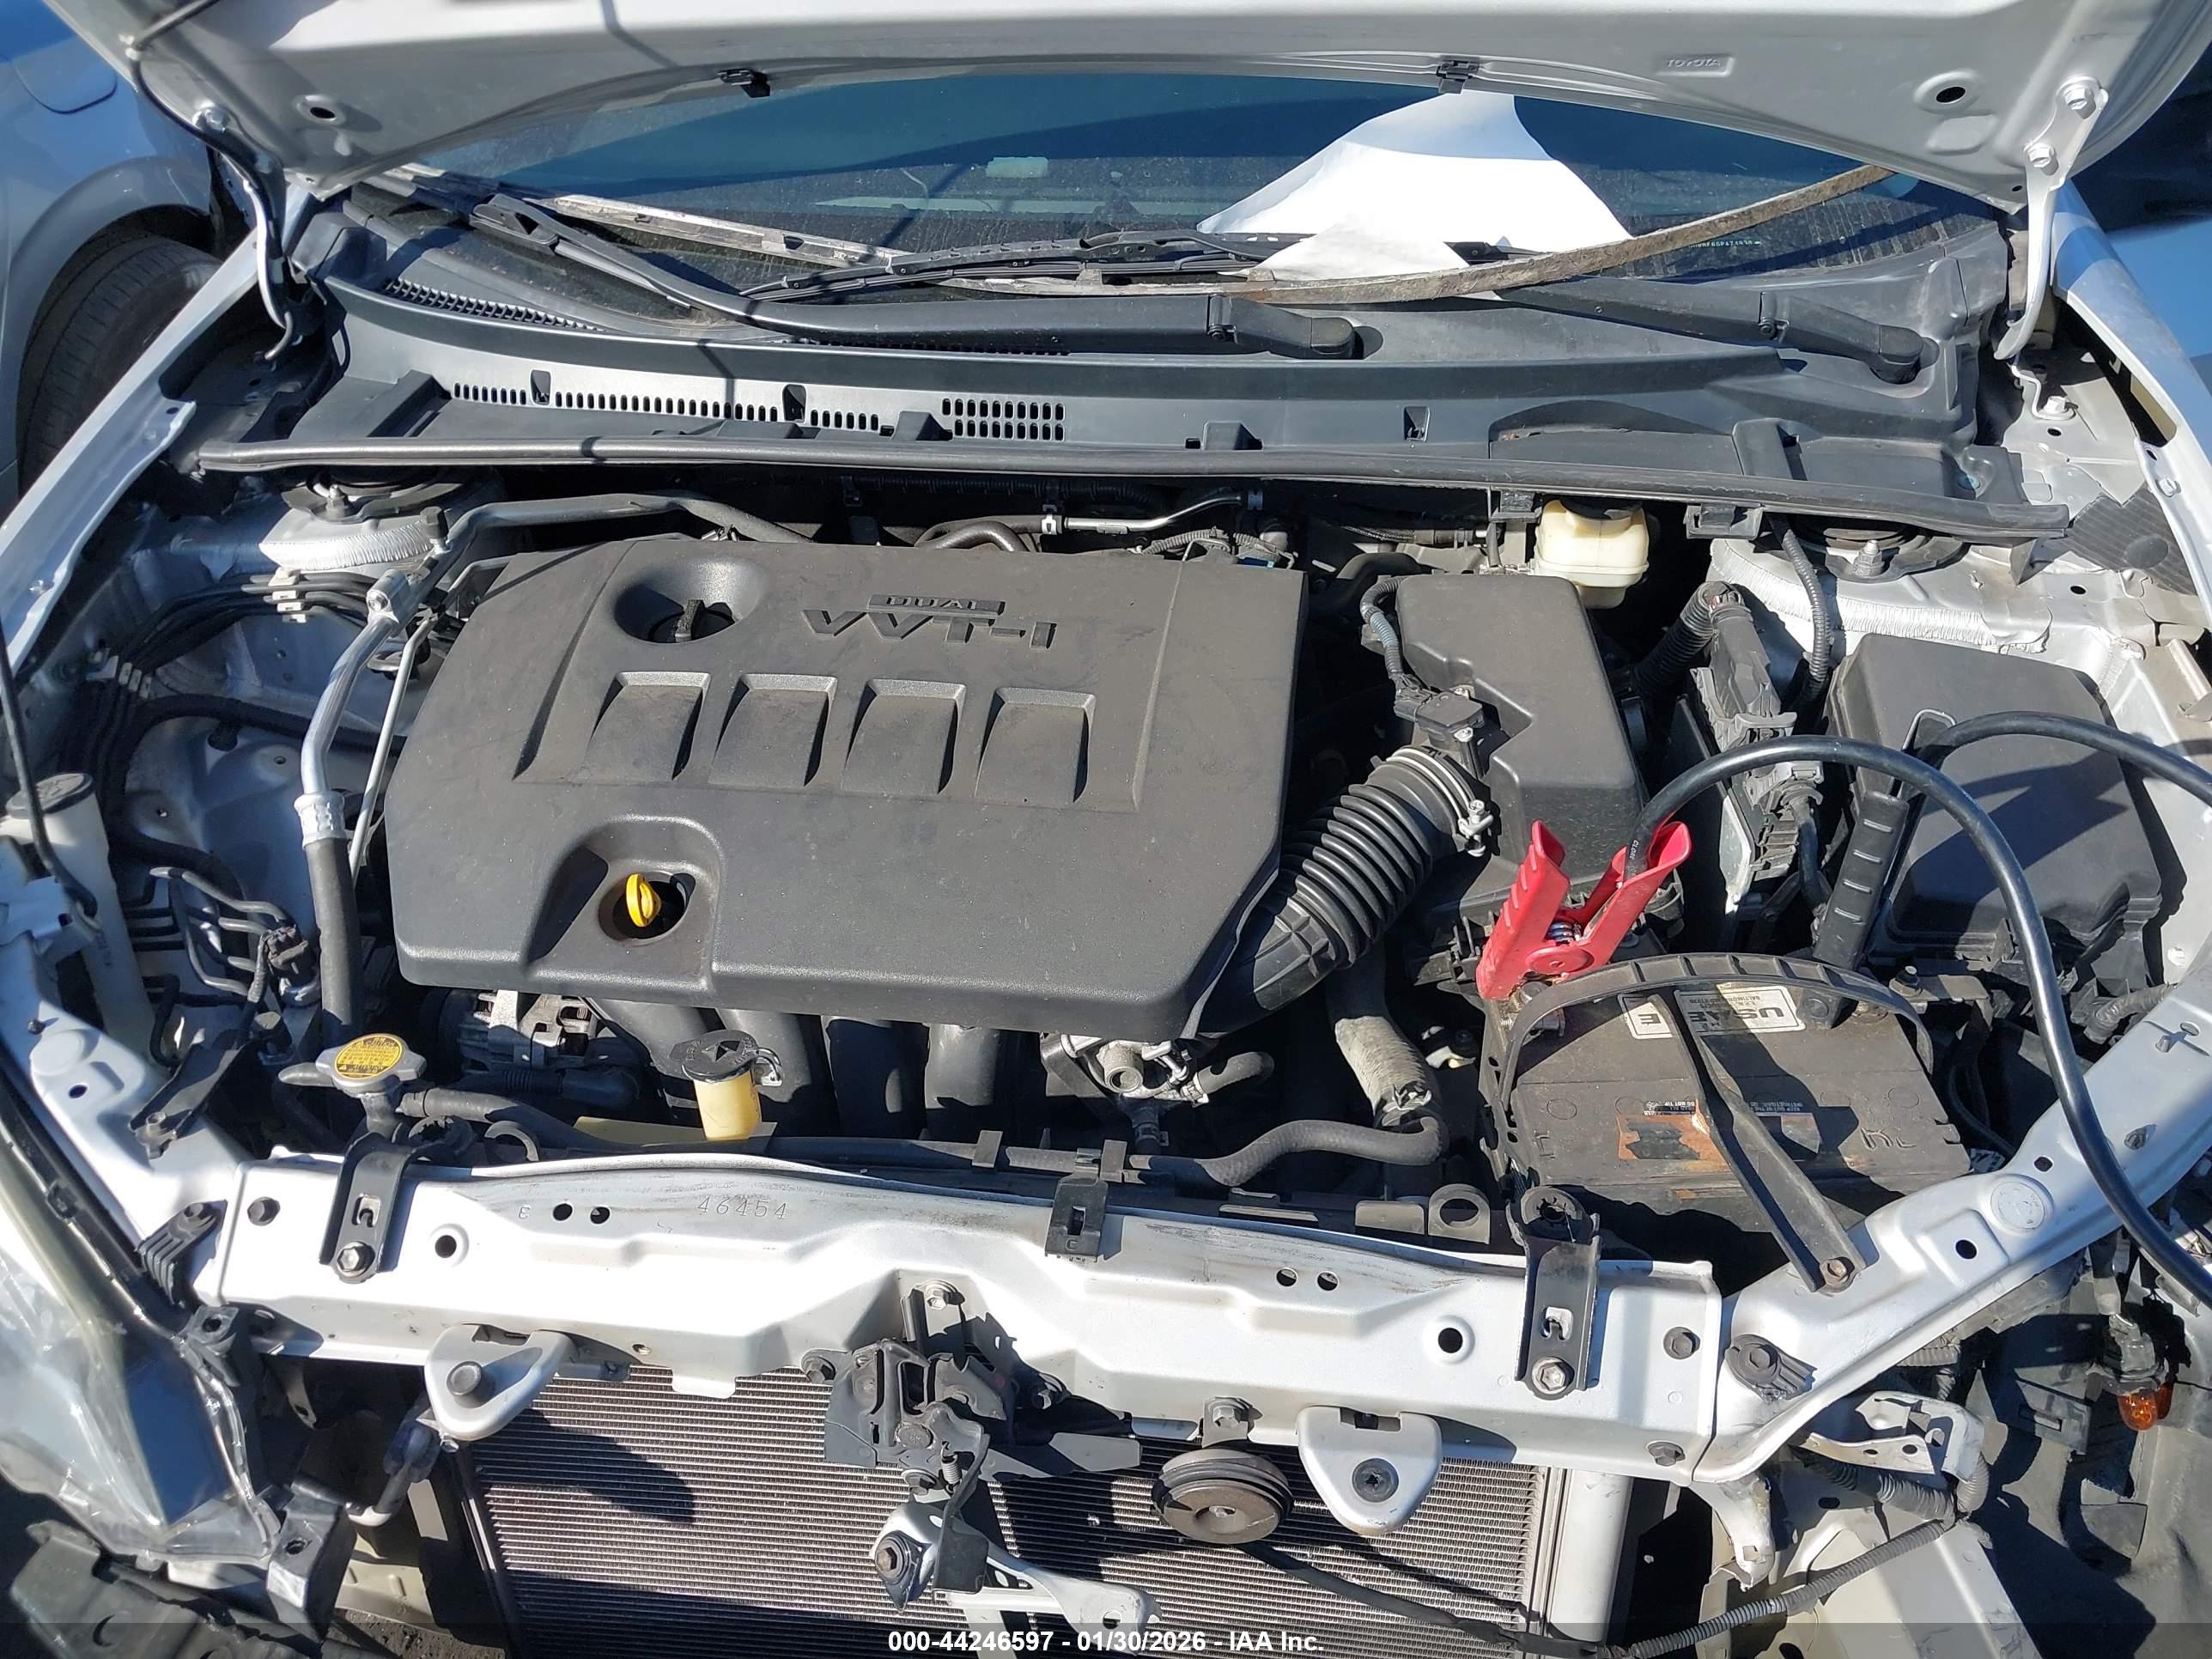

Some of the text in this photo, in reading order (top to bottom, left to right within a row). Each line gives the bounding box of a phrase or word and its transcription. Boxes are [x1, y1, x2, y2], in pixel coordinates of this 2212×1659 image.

[1668, 58, 1719, 68] TOYOTA
[885, 596, 977, 610] DUAL
[697, 1196, 787, 1220] 46454
